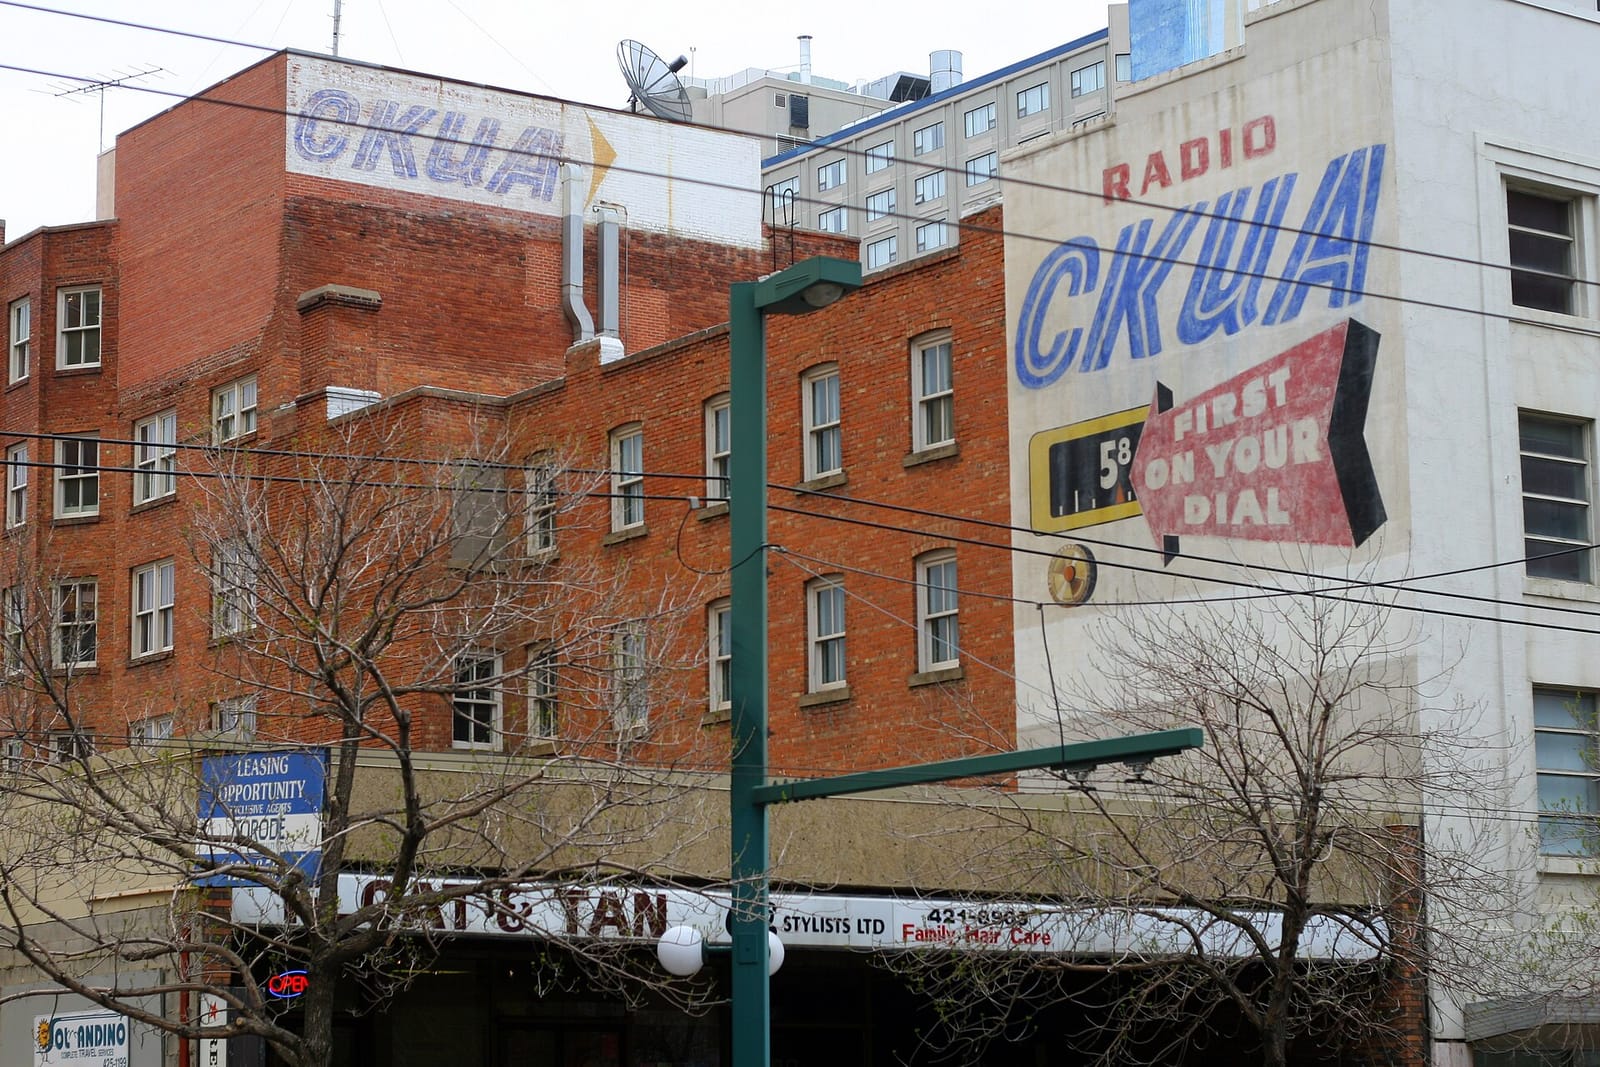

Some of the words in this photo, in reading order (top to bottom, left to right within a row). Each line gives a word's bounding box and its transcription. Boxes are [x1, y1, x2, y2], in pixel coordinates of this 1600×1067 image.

[293, 88, 565, 203] CKUA
[1102, 114, 1277, 207] RADIO
[1014, 143, 1387, 390] CKUA
[1174, 367, 1292, 442] FIRST
[1144, 447, 1196, 490] ON
[1203, 418, 1322, 480] YOUR
[1183, 487, 1291, 526] DIAL
[237, 756, 289, 777] LEASING
[218, 780, 306, 802] OPPORTUNITY
[553, 888, 668, 938] TAN
[783, 915, 850, 934] STYLISTS
[857, 917, 885, 935] LTD
[902, 923, 955, 946] Family
[965, 925, 1001, 944] Hair
[1011, 927, 1051, 945] Care
[77, 1022, 126, 1049] ANDINO
[79, 1048, 97, 1058] TRAVEL
